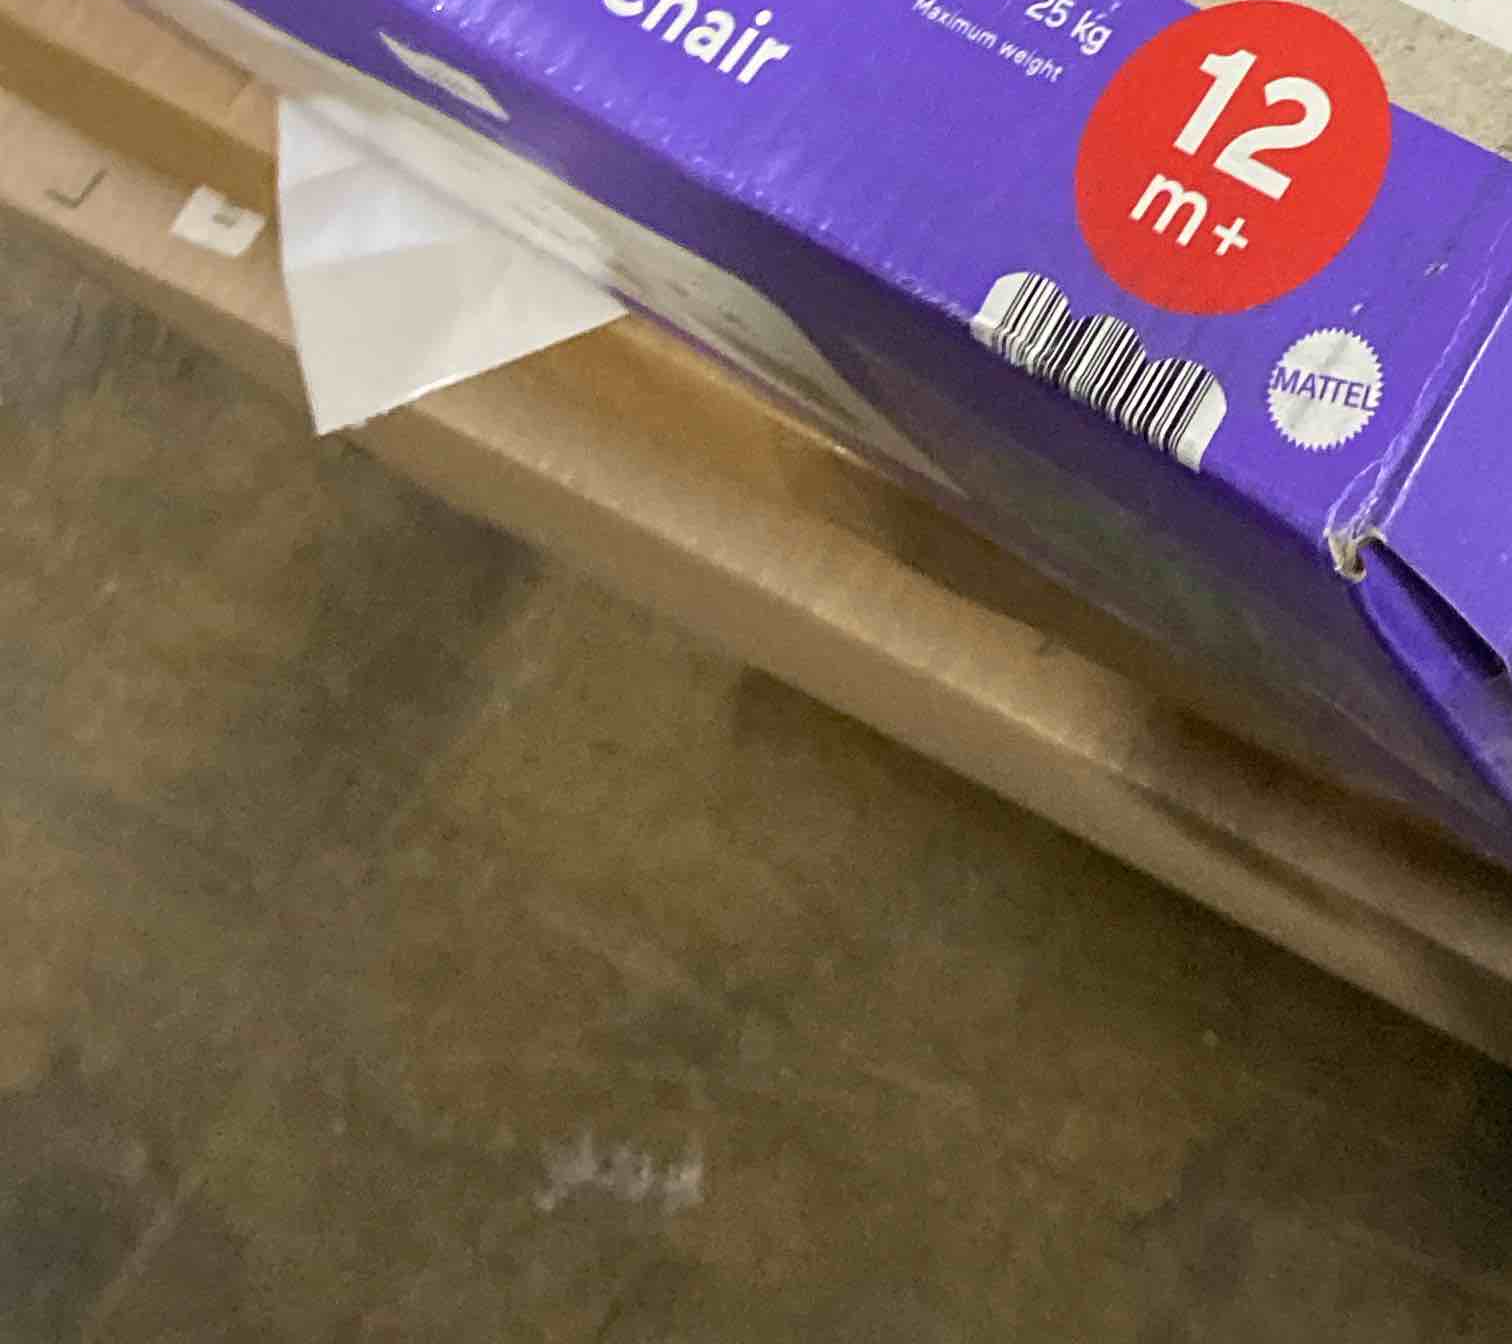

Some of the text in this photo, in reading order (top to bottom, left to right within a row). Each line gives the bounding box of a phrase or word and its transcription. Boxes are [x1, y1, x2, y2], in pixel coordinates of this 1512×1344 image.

[1071, 9, 1113, 55] kg
[999, 40, 1064, 83] weight
[1173, 47, 1332, 202] 12
[1129, 170, 1250, 257] m+
[1271, 366, 1379, 413] MATTEL
